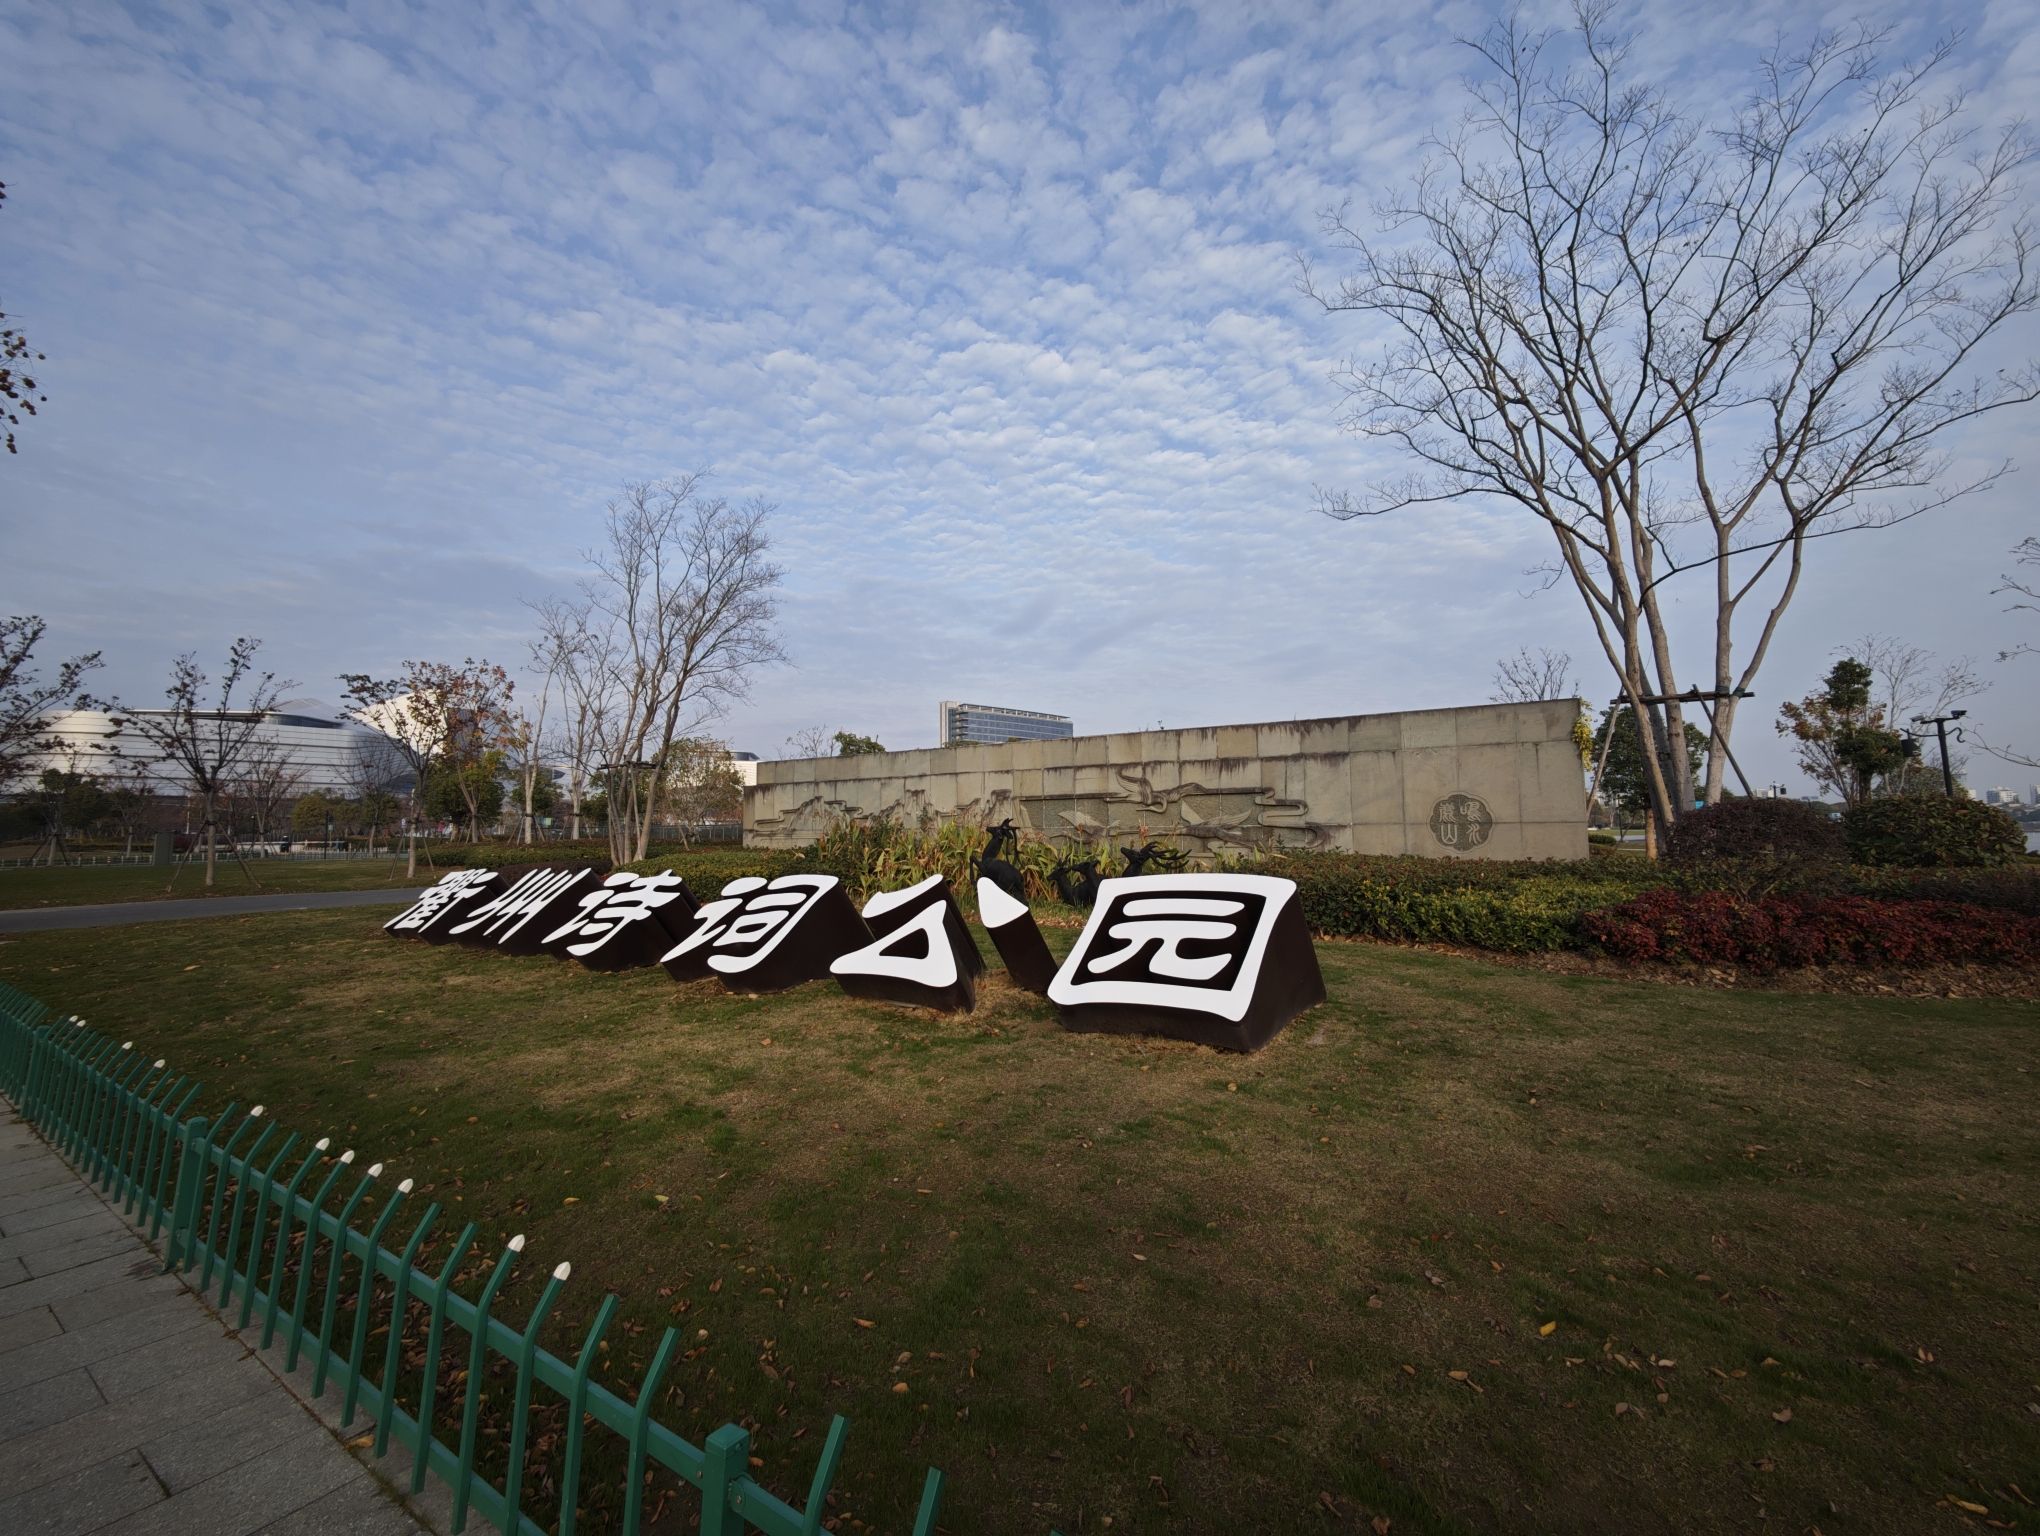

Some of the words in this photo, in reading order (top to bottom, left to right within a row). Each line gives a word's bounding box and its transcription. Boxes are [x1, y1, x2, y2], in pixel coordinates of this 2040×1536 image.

[384, 868, 1297, 1022] 衢州诗词公园
